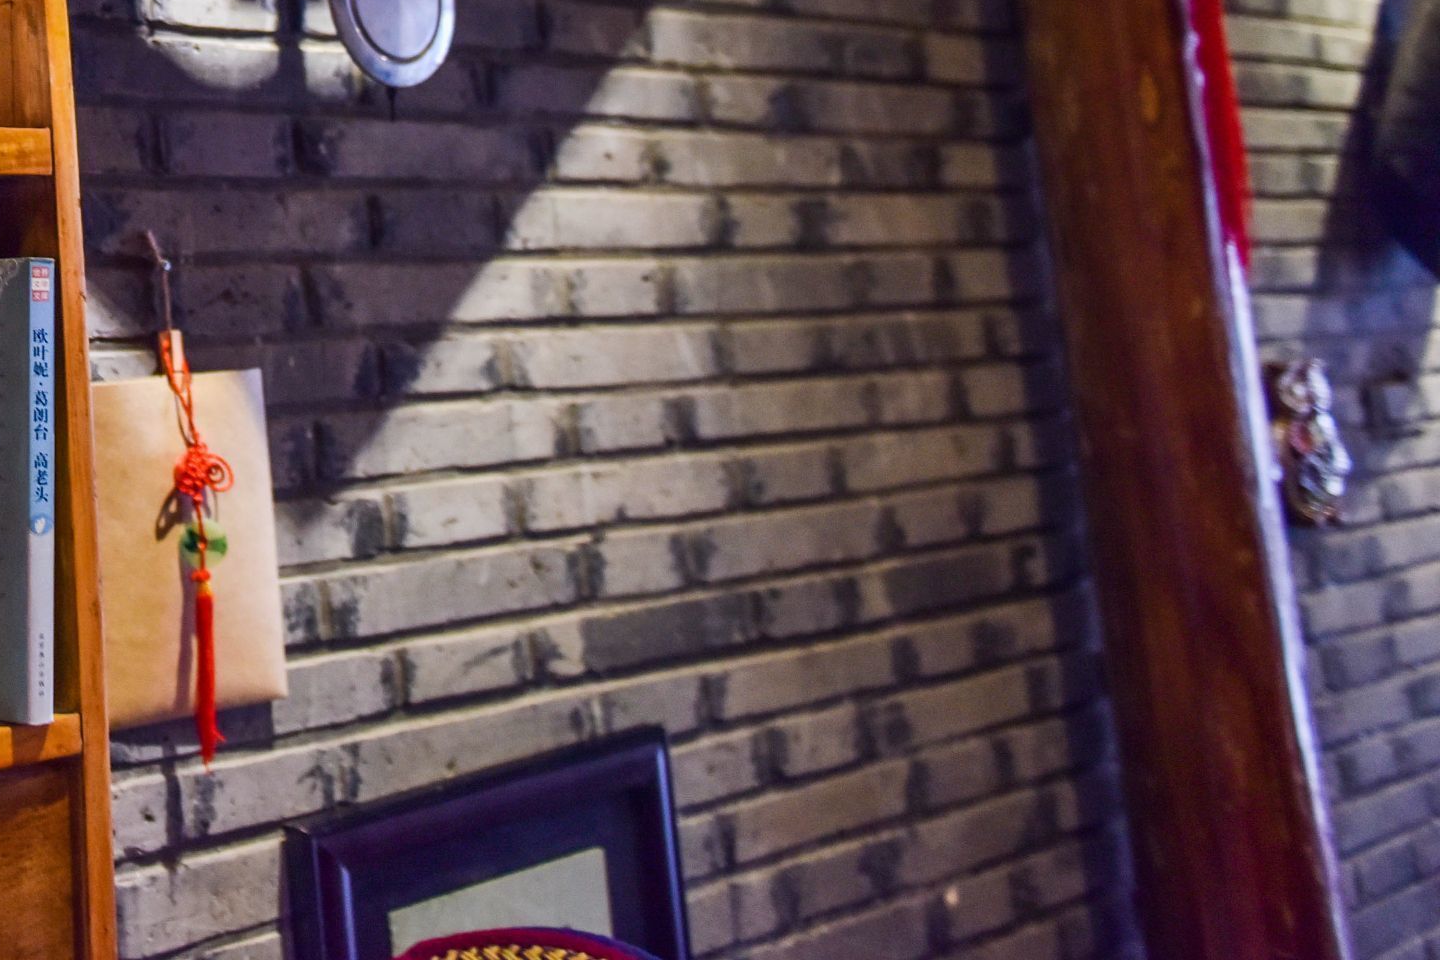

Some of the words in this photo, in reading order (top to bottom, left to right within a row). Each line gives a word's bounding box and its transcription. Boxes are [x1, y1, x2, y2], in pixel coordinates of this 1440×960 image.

[32, 328, 49, 441] 欧叶妮·葛朗台
[33, 451, 49, 503] 高老头
